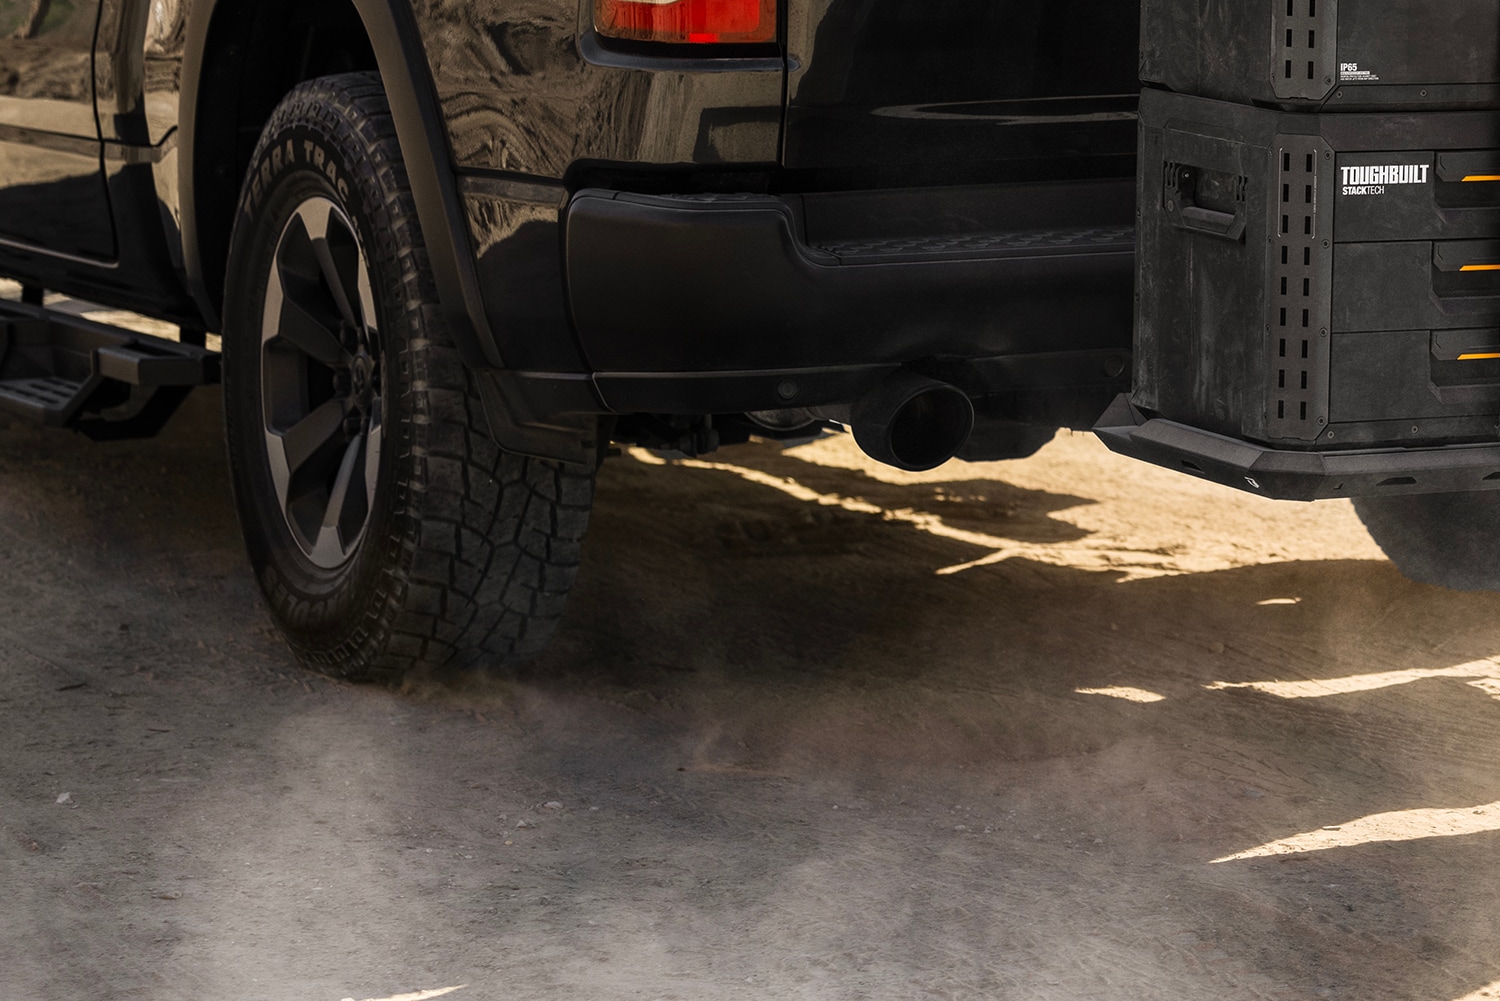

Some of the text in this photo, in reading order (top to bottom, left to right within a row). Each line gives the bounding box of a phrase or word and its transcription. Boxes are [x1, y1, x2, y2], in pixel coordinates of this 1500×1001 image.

[1340, 62, 1358, 71] IP65
[304, 139, 348, 202] TRAC
[1341, 164, 1430, 185] TOUGHBUILT
[1342, 185, 1385, 195] STACKTECH
